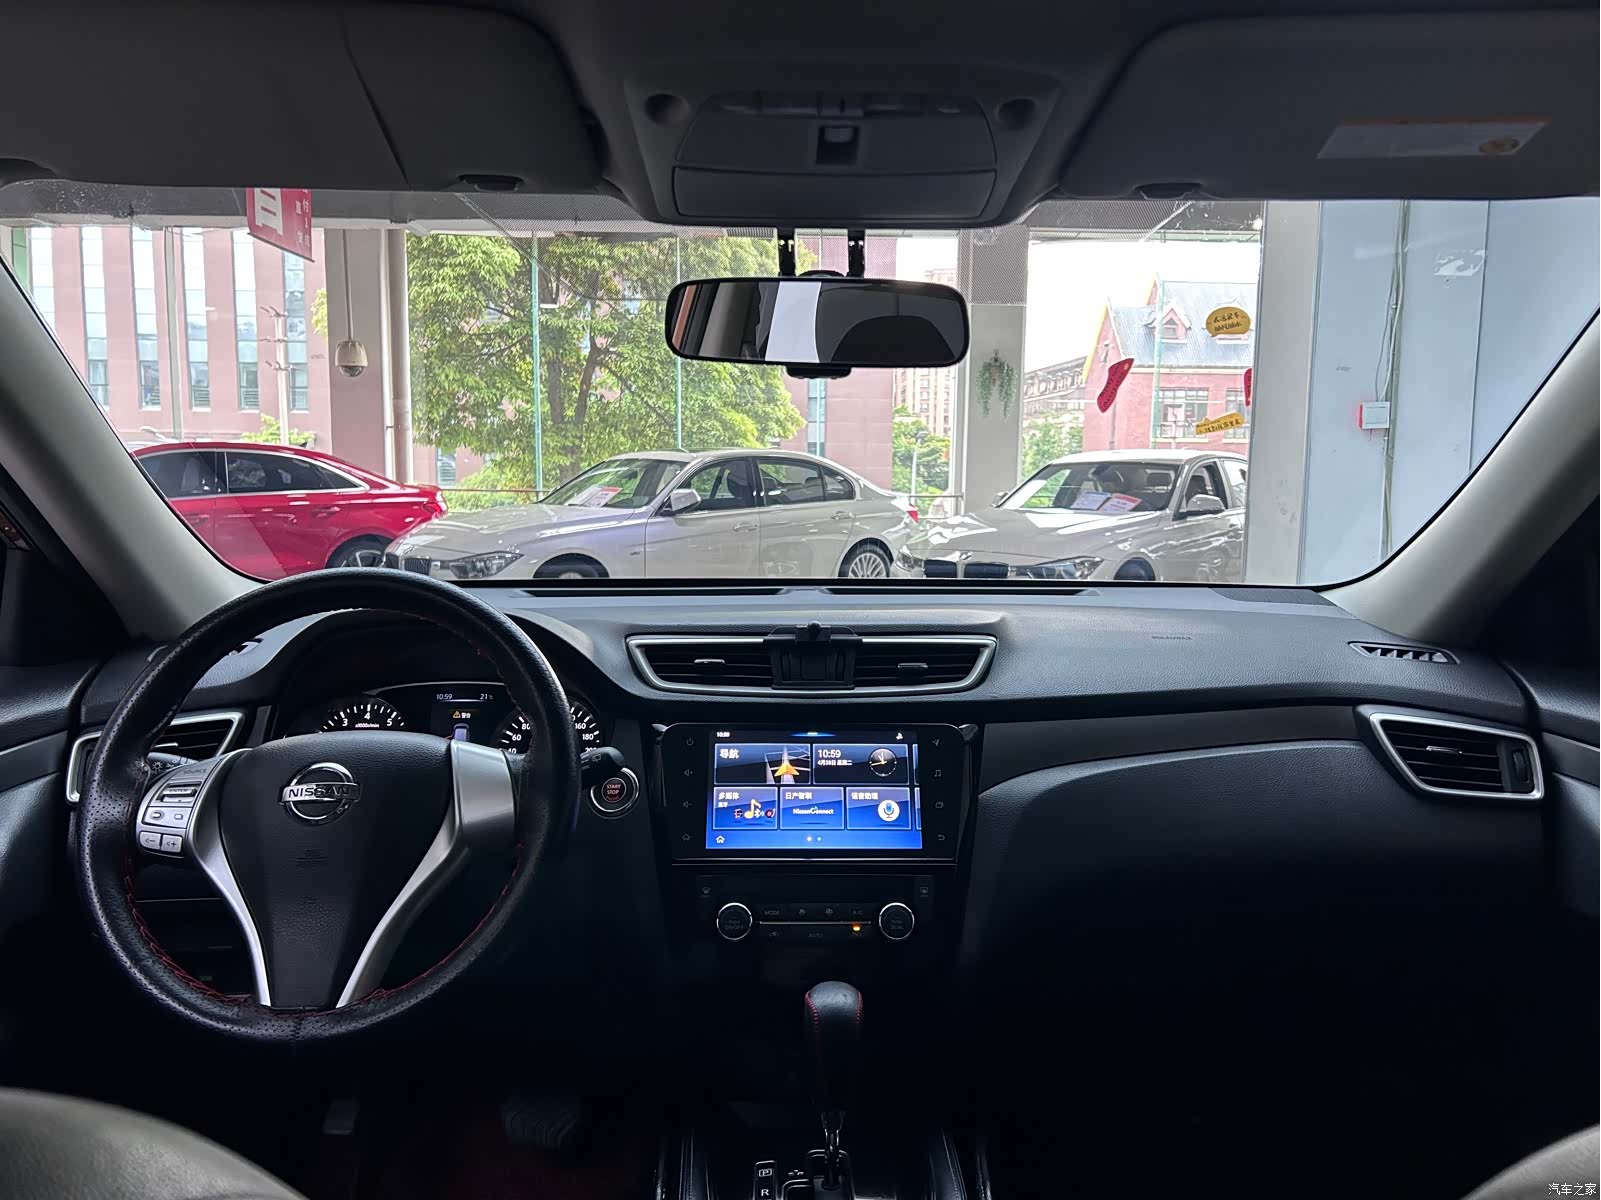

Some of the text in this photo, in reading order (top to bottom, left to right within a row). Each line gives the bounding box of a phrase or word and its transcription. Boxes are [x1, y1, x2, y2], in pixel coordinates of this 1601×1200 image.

[364, 712, 371, 720] 4
[342, 718, 348, 727] 3
[386, 718, 393, 727] 5
[574, 722, 586, 730] 160
[511, 733, 522, 741] 60
[582, 733, 594, 741] 180
[719, 748, 740, 759] 导航
[817, 749, 842, 758] 10:59
[288, 786, 350, 798] NISSAN
[718, 792, 740, 801] 多媒体
[760, 1188, 770, 1197] R
